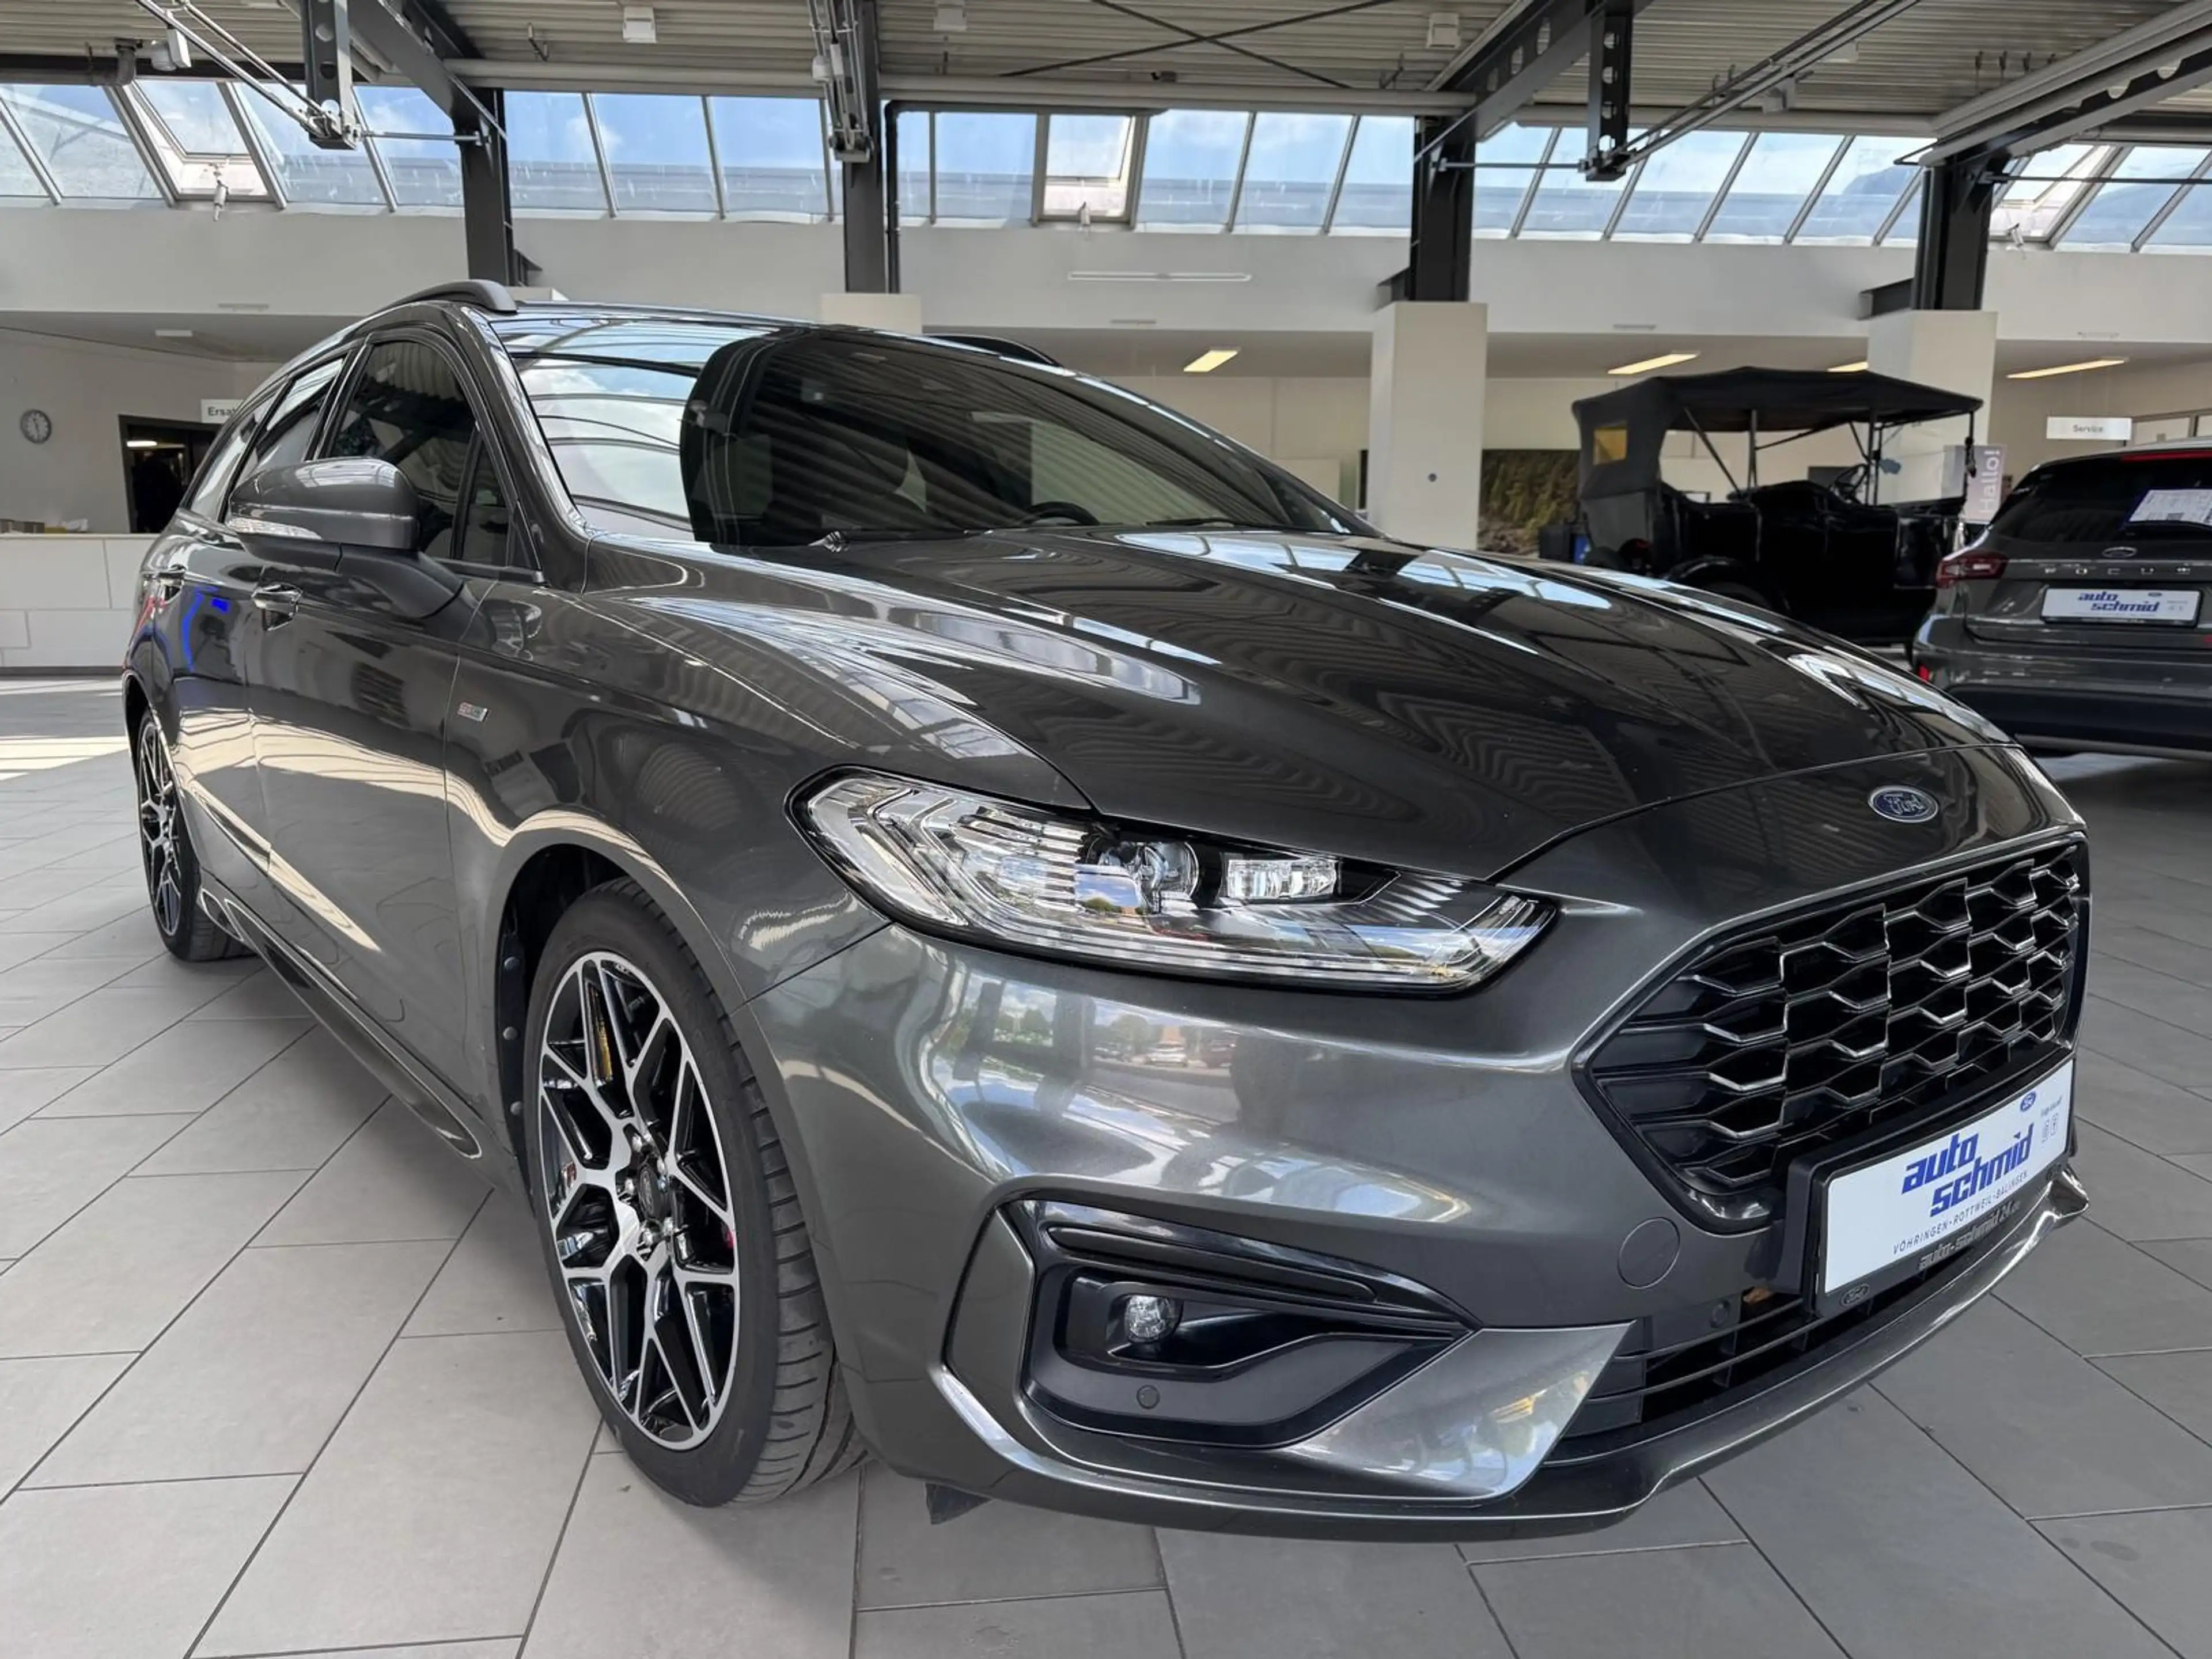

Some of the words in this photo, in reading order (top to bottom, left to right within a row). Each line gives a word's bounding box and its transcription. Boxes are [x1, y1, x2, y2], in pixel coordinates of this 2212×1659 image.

[2073, 424, 2103, 433] Service
[1980, 449, 2001, 513] Hallo!
[2077, 591, 2119, 601] auto
[2090, 601, 2161, 612] schmid
[1901, 1132, 1979, 1195] auto
[1930, 1122, 2035, 1218] schmid
